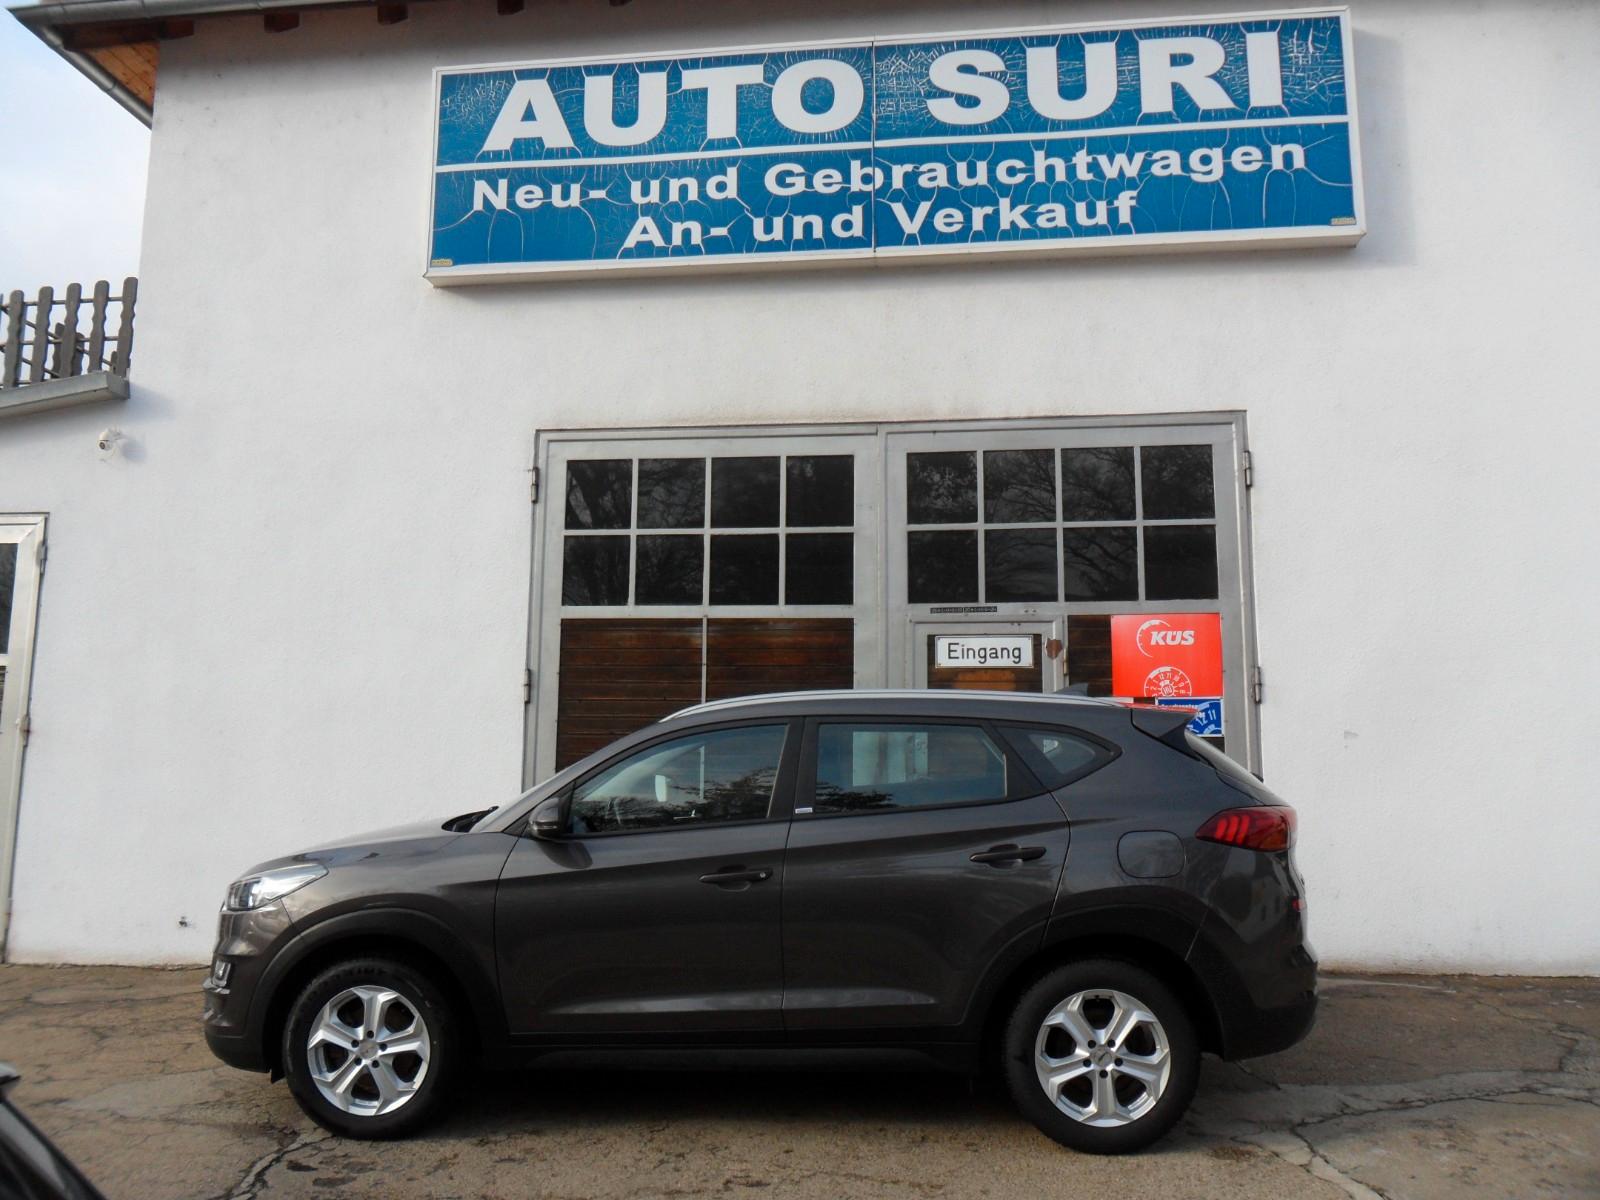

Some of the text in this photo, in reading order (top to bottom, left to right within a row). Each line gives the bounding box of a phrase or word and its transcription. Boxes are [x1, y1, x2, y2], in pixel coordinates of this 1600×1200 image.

[483, 31, 1284, 151] AUTO SURI
[473, 142, 1306, 211] Neu- und Gebrauchtwagen
[623, 190, 1137, 247] An- und Verkauf
[948, 642, 1021, 664] Eingang
